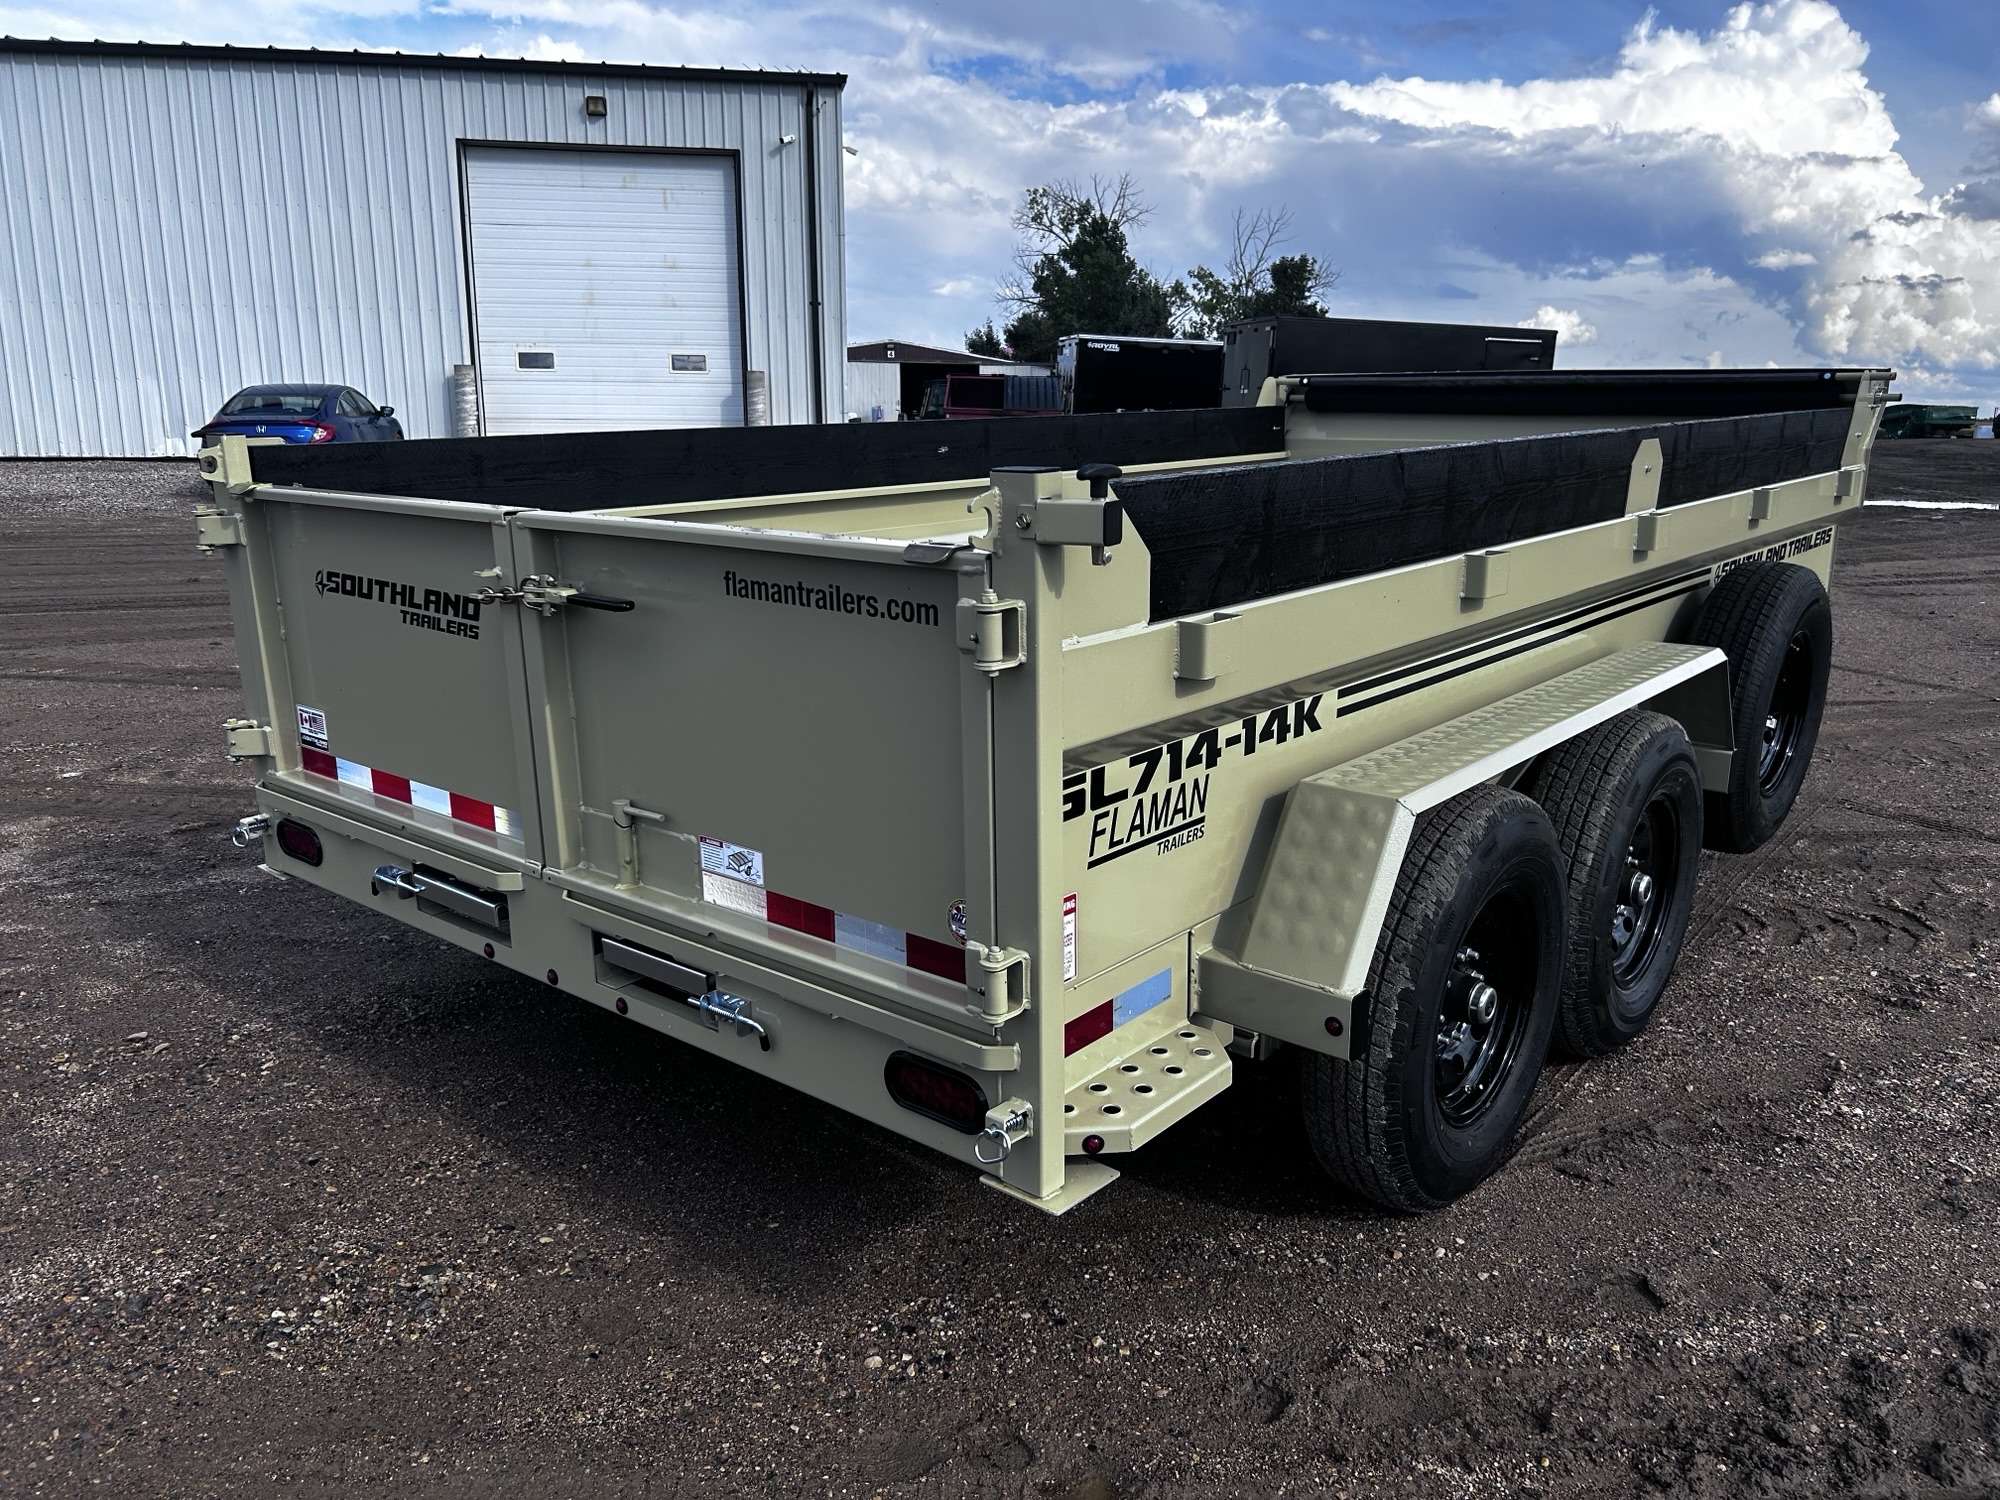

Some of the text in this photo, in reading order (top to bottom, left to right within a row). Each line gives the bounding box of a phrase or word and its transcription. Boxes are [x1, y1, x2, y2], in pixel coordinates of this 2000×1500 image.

[1787, 527, 1833, 558] TRAILERS
[326, 570, 481, 621] SOUTHLAND
[723, 570, 939, 627] flamantrailers.com
[400, 609, 480, 640] TRAILERS
[1062, 694, 1322, 823] SL714-14K
[1089, 773, 1210, 858] FLAMAN
[1156, 824, 1205, 856] TRAILERS
